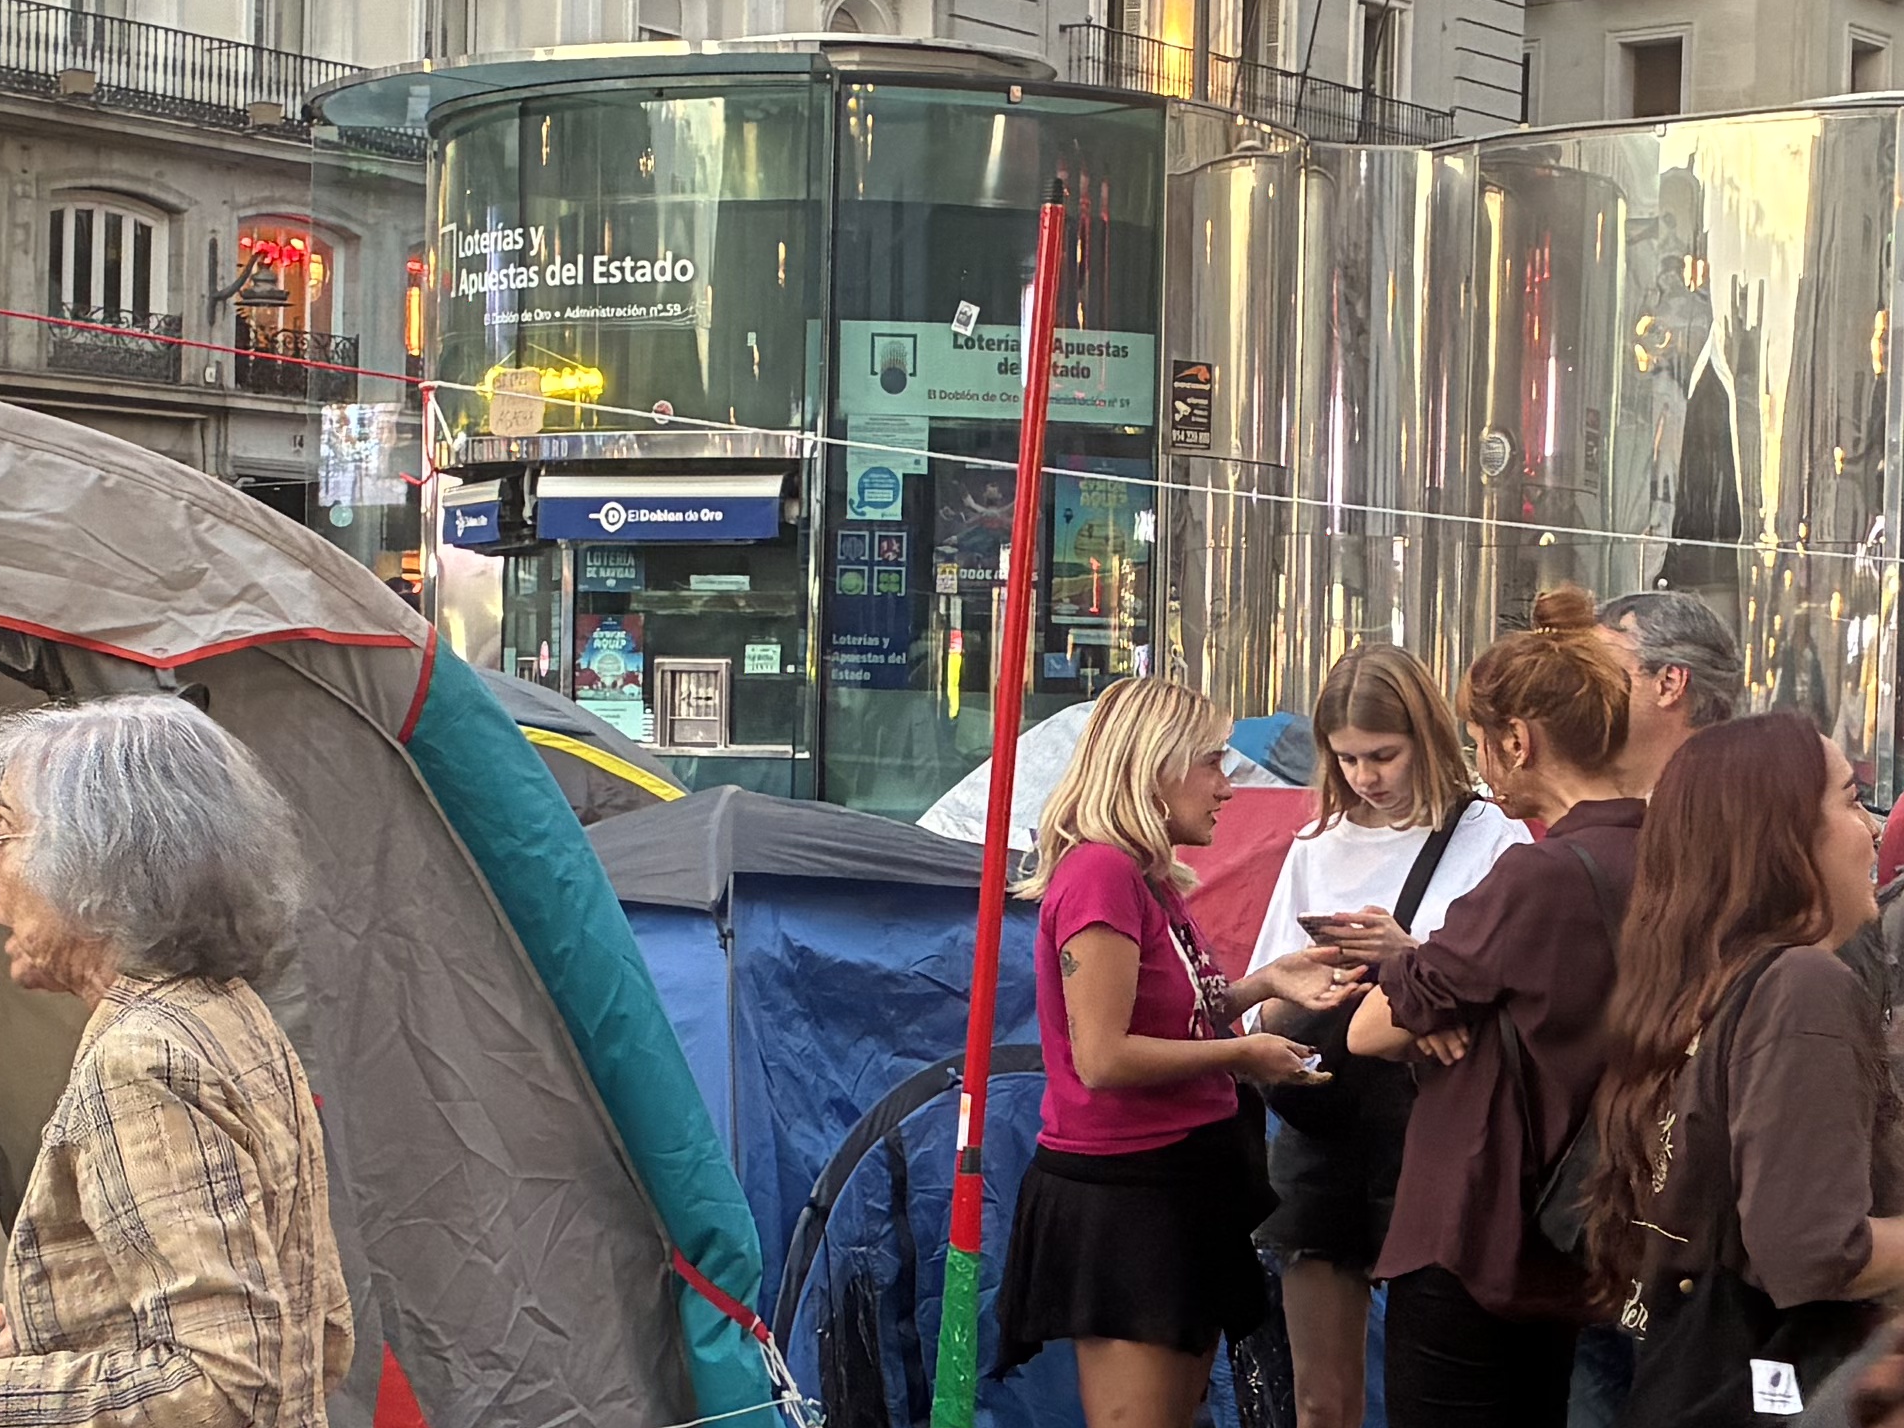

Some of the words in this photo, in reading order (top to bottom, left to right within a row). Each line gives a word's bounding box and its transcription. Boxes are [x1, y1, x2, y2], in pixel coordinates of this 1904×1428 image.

[458, 223, 523, 259] Loterías
[530, 225, 544, 256] y
[458, 263, 539, 302] Apuestas
[546, 254, 583, 287] del
[593, 250, 694, 285] Estado
[521, 309, 532, 322] de
[534, 308, 552, 321] Oro
[564, 305, 646, 320] Administración
[666, 303, 682, 316] 59
[1052, 337, 1129, 360] Apuestas
[939, 389, 979, 403] Doblón
[982, 390, 997, 403] de
[999, 391, 1020, 404] Oro
[700, 508, 724, 523] Oro
[600, 567, 637, 579] NAVIDAD
